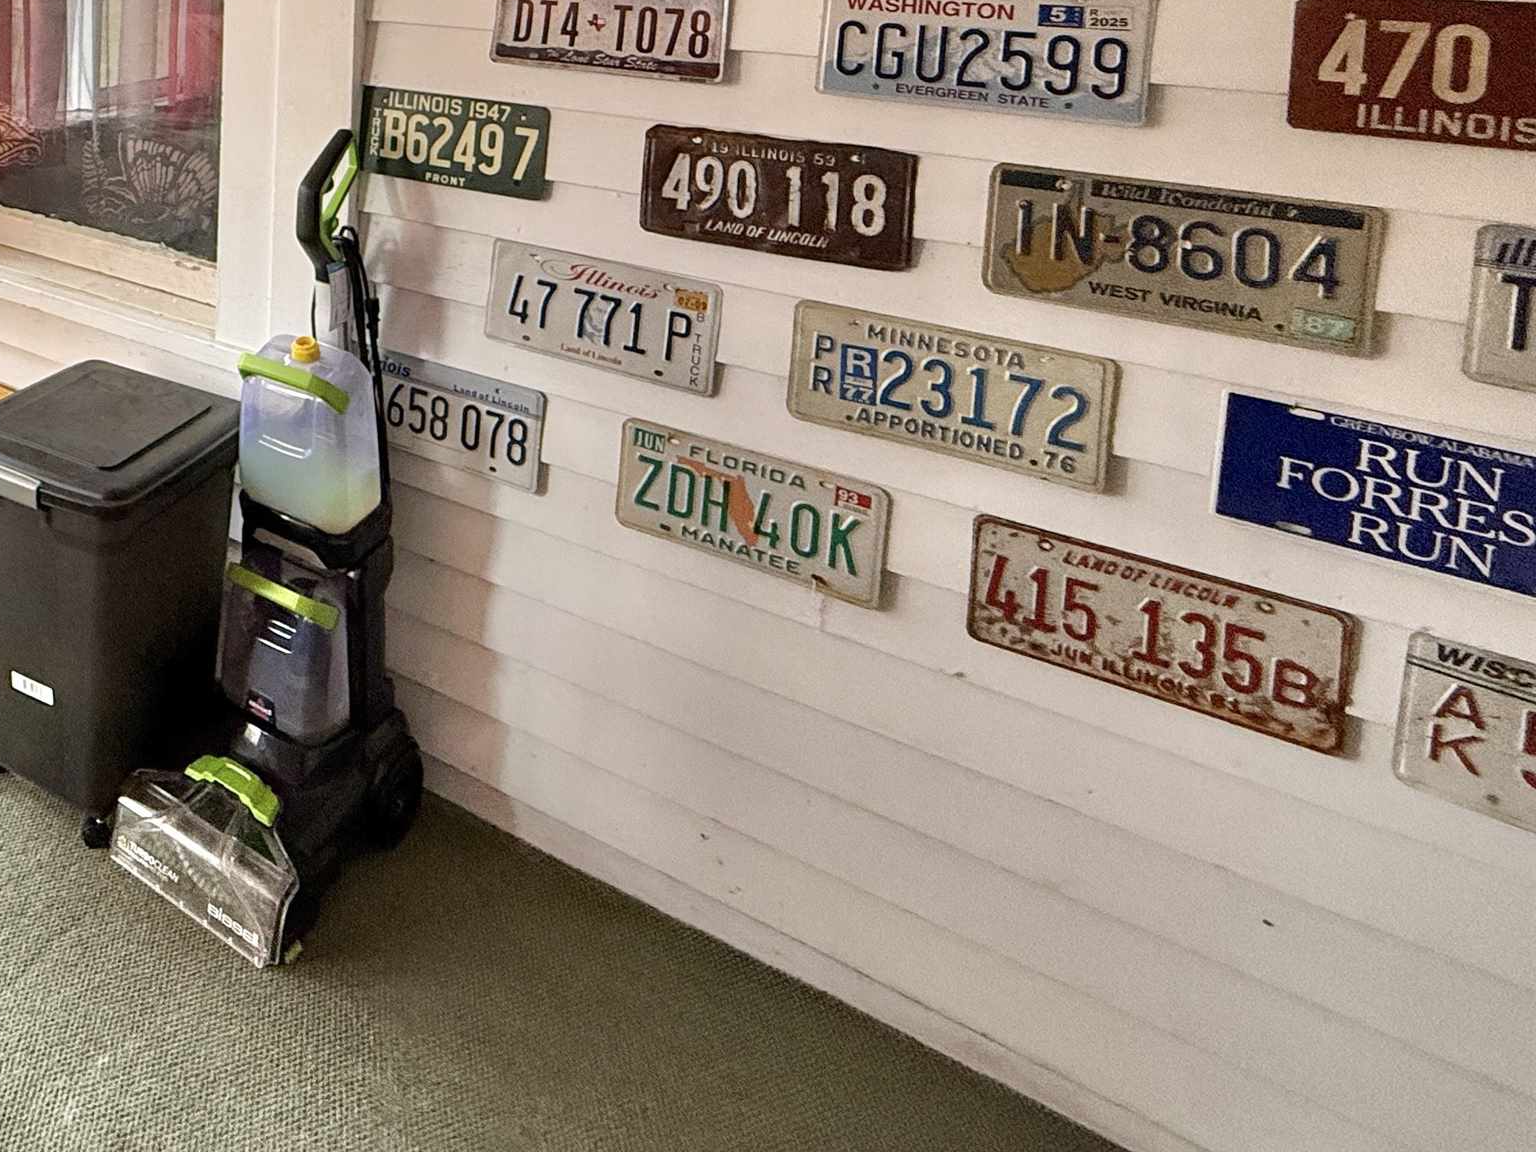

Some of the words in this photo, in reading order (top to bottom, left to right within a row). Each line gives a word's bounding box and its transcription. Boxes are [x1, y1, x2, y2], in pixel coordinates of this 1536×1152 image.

[513, 0, 580, 46] DT4
[1048, 6, 1067, 22] 5
[1089, 17, 1129, 28] 2025
[834, 20, 1129, 100] CGU2599
[1318, 19, 1491, 105] 470
[388, 91, 463, 116] ILLINOIS
[469, 100, 512, 122] 1947
[895, 83, 989, 103] EVERGREEN
[997, 94, 1050, 109] STATE
[379, 109, 540, 181] B62497
[736, 144, 806, 164] ILLINOIS
[425, 172, 466, 187] FRONT
[661, 153, 757, 219] 490
[786, 166, 887, 237] 118
[705, 219, 745, 236] LAND
[746, 225, 766, 238] OF
[767, 228, 830, 250] LINCOLN
[563, 263, 662, 299] Illinois
[1088, 280, 1151, 303] WEST
[1159, 290, 1264, 323] VIRGINIA
[508, 275, 558, 329] 47
[574, 288, 646, 356] 771
[665, 310, 692, 362] P
[688, 334, 703, 388] TRUCK
[868, 324, 1025, 370] MINNESOTA
[387, 384, 449, 441] 658
[460, 405, 528, 466] 078
[879, 350, 1089, 452] 23172
[635, 429, 664, 452] JUN
[855, 408, 1025, 461] APPORTIONED
[1042, 451, 1078, 473] 76
[689, 445, 806, 490] FLORIDA
[1356, 439, 1504, 501] RUN
[634, 454, 731, 532] ZDH
[838, 489, 859, 505] 93
[681, 525, 801, 575] MANATEE
[1348, 511, 1496, 578] RUN
[984, 554, 1098, 642] 415
[1064, 550, 1118, 576] LAND
[1120, 565, 1148, 583] OF
[1150, 573, 1239, 608] LINCOLN
[1102, 657, 1201, 698] ILLINOIS
